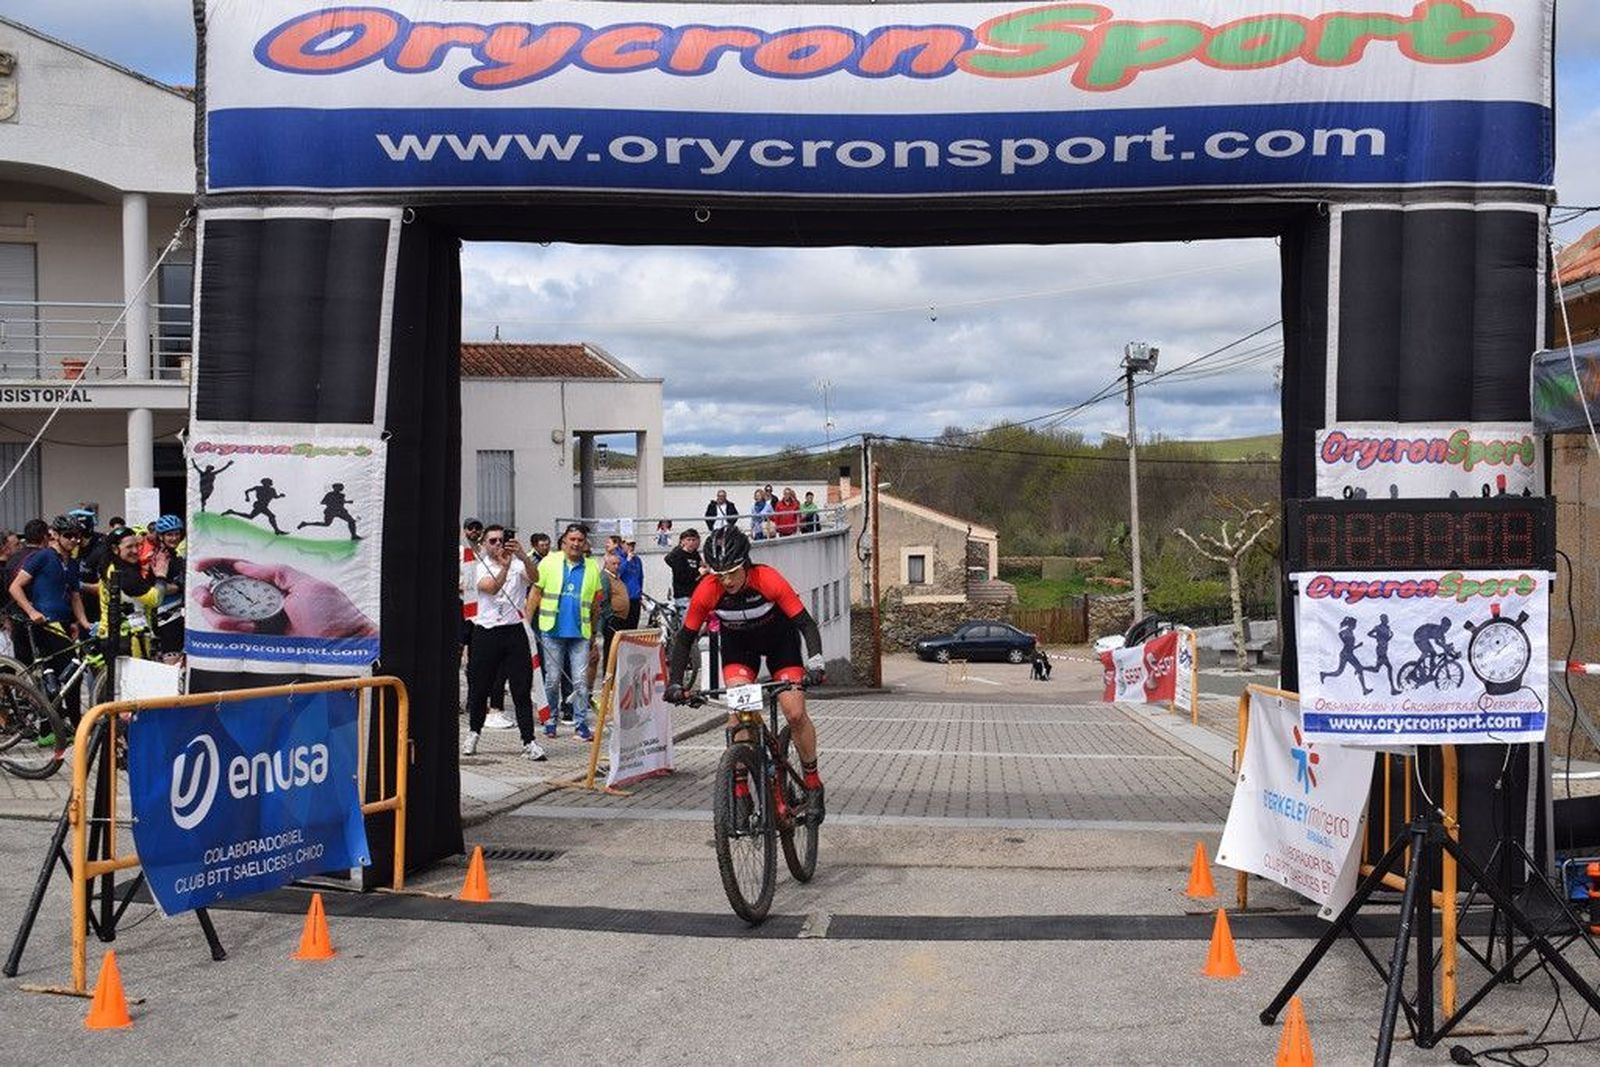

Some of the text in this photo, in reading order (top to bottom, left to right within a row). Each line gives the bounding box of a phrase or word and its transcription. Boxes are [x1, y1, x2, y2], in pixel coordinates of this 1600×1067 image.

[253, 1, 1514, 92] OrycronSport
[375, 125, 1387, 175] www.orycronsport.com
[0, 389, 92, 402] SISTORIAL
[1321, 429, 1535, 471] OrycronSport
[1306, 571, 1536, 603] OrycronSport
[191, 639, 368, 657] www.orycronsport.com
[1329, 715, 1522, 733] www.orycronsport.com
[228, 743, 329, 799] enusa
[203, 833, 289, 865] COLABORADOR
[174, 873, 206, 895] CLUB
[206, 866, 231, 887] BTT
[233, 854, 287, 881] SAELICES
[295, 843, 324, 864] CHICO
